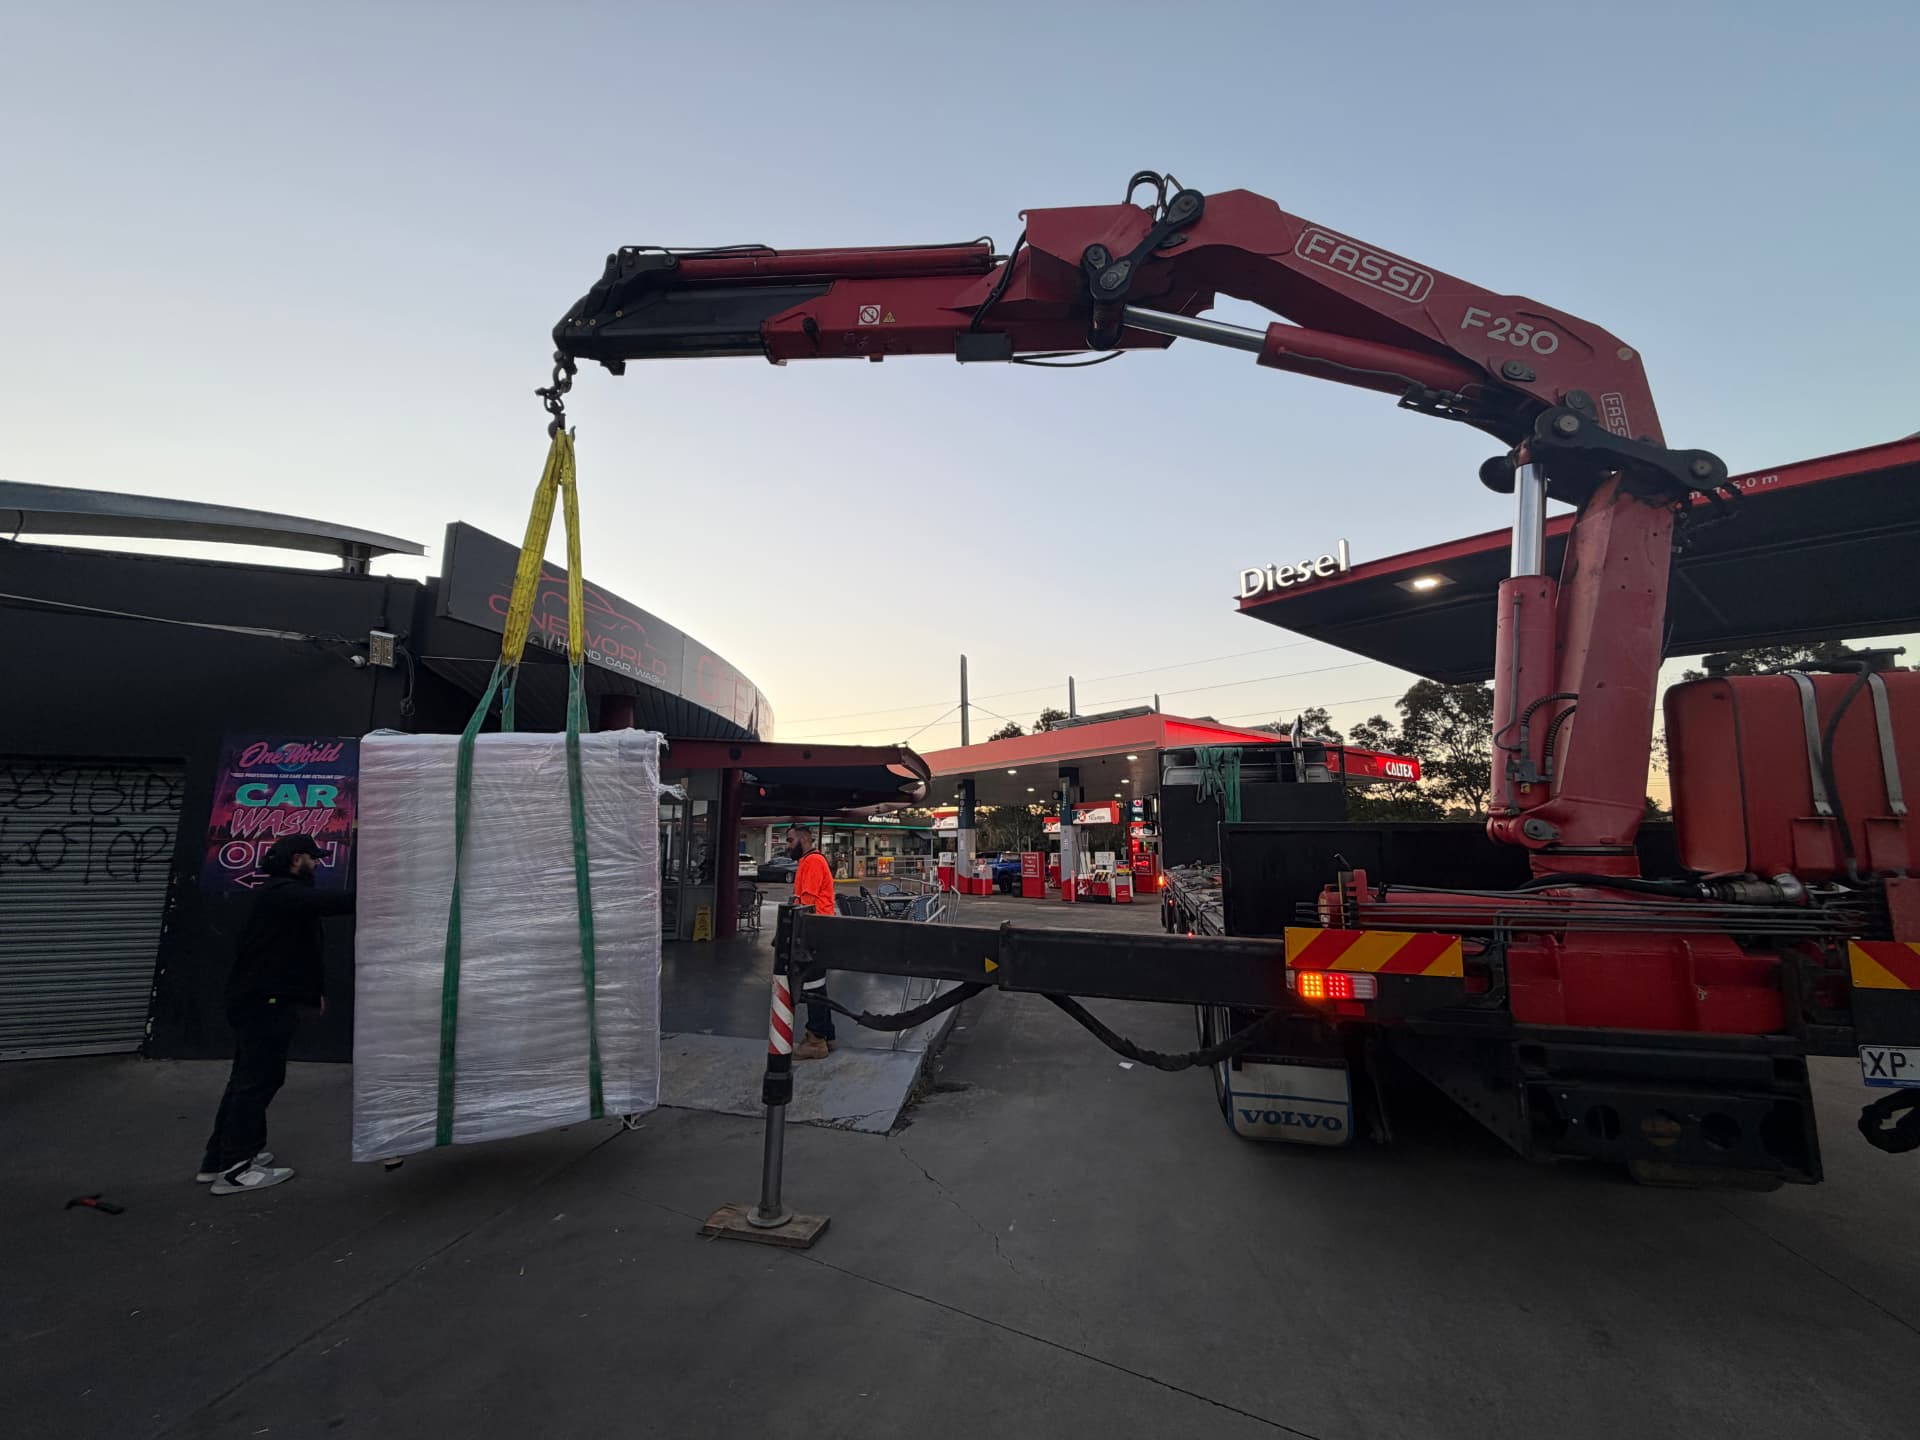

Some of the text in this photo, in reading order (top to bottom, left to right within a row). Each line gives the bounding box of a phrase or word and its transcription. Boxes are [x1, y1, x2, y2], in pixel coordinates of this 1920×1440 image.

[1304, 233, 1426, 298] FASSI
[1605, 397, 1627, 437] FASS
[1762, 474, 1779, 485] m
[1240, 539, 1350, 599] Diesel
[557, 637, 666, 686] HND CAR WASH
[239, 741, 344, 768] One World
[1385, 761, 1415, 779] CALTEX
[235, 782, 340, 808] CAR
[230, 808, 335, 840] WASH
[218, 840, 337, 870] ON
[1867, 1051, 1907, 1078] XP
[1238, 1108, 1343, 1131] VOLVO
